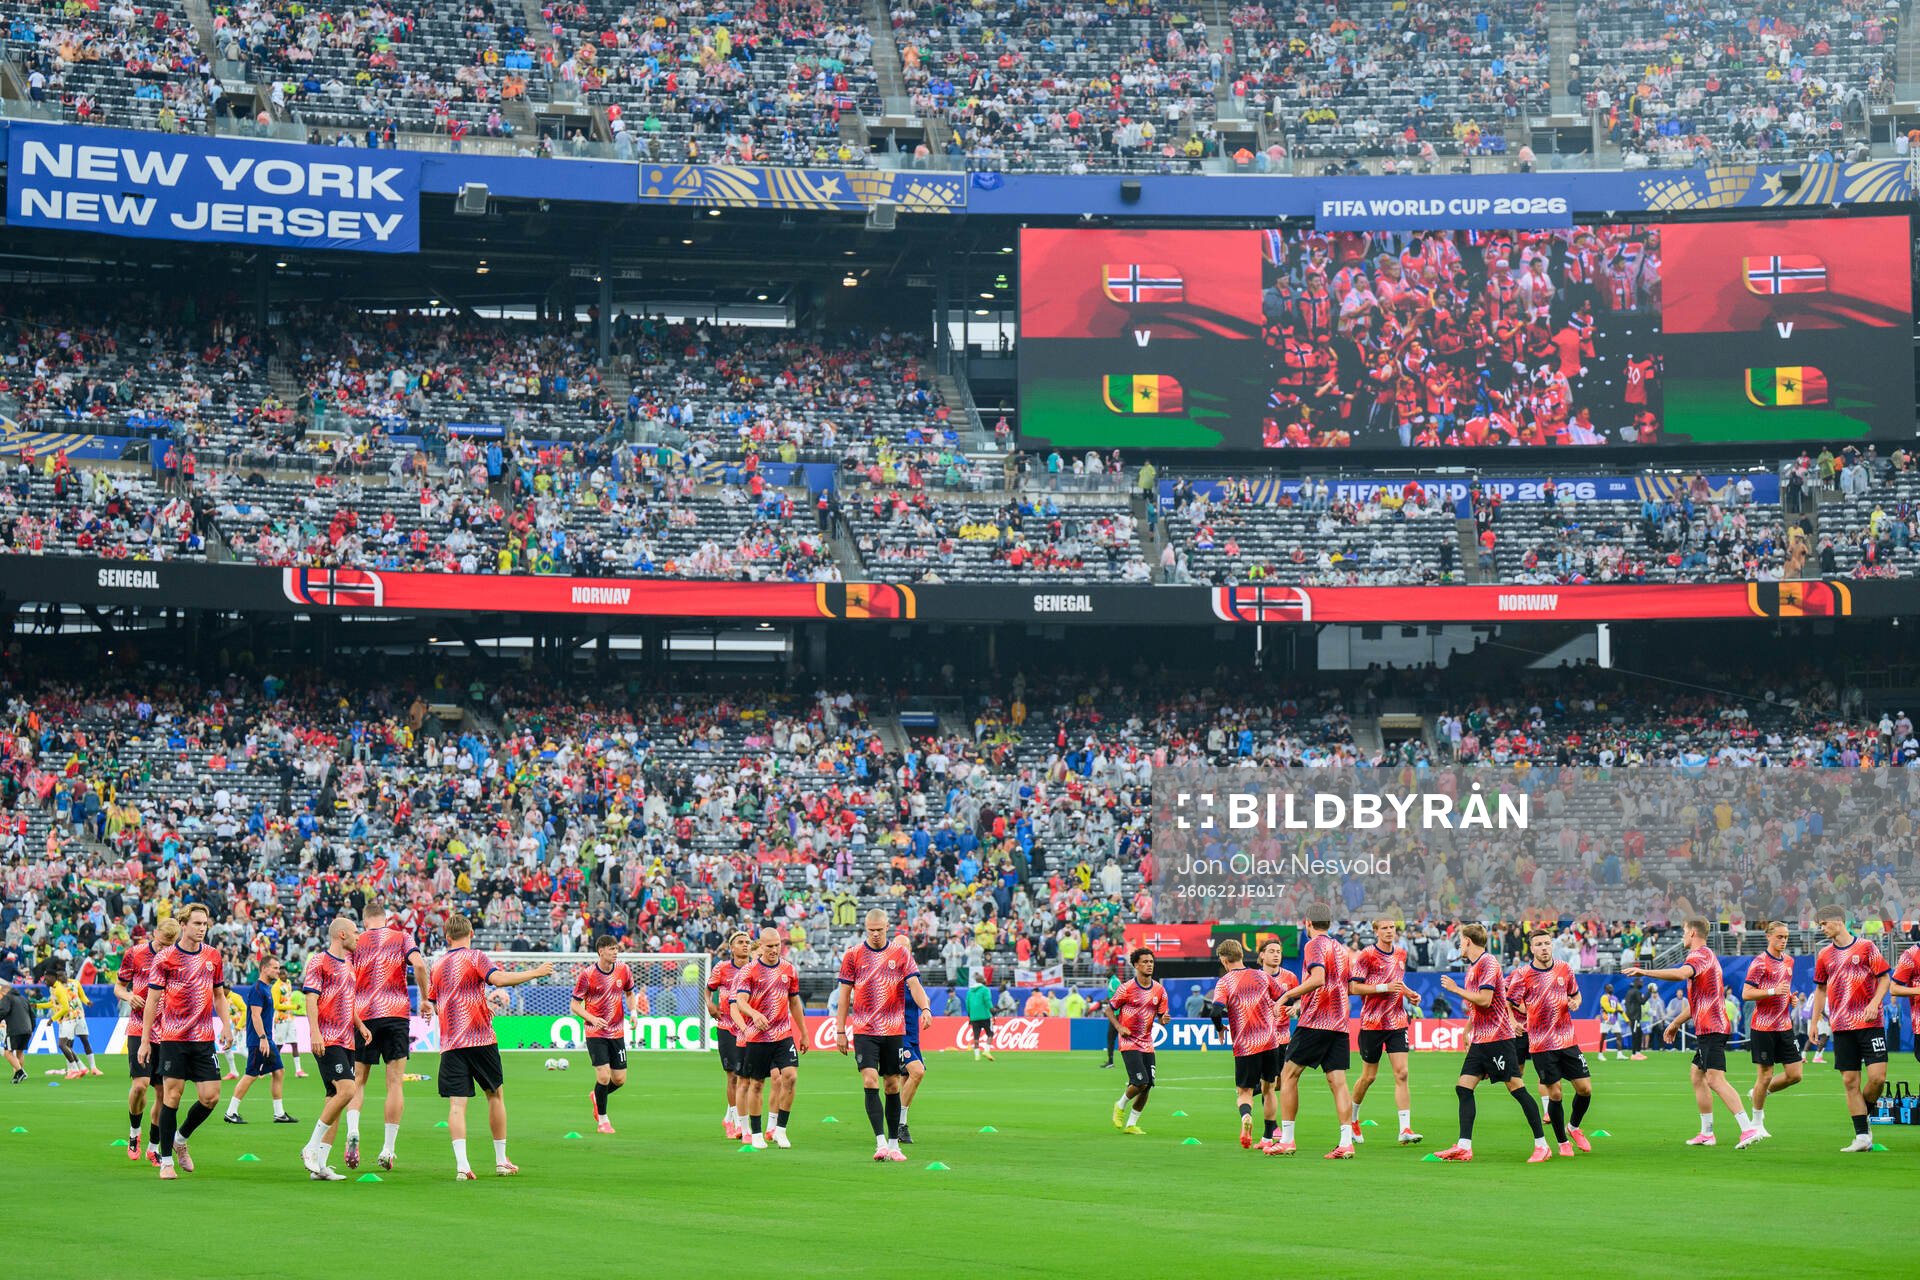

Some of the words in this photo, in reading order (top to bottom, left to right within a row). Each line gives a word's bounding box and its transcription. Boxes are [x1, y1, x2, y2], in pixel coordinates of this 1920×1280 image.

[21, 140, 189, 186] NEW
[205, 155, 404, 202] YORK
[20, 188, 157, 226] NEW
[170, 201, 403, 241] JERSEY
[1322, 200, 1368, 217] FIFA
[1369, 199, 1446, 217] WORLD
[1449, 198, 1491, 216] CUP
[1493, 197, 1567, 215] 2026
[1386, 483, 1468, 501] WRLD
[1479, 483, 1515, 500] UP
[97, 568, 160, 589] SENEGAL
[571, 586, 631, 605] NORWAY
[1033, 594, 1094, 612] SENEGAL
[1498, 594, 1559, 612] NORWAY
[618, 1048, 627, 1062] 11
[788, 1044, 797, 1057] 4
[1492, 1055, 1506, 1071] 16
